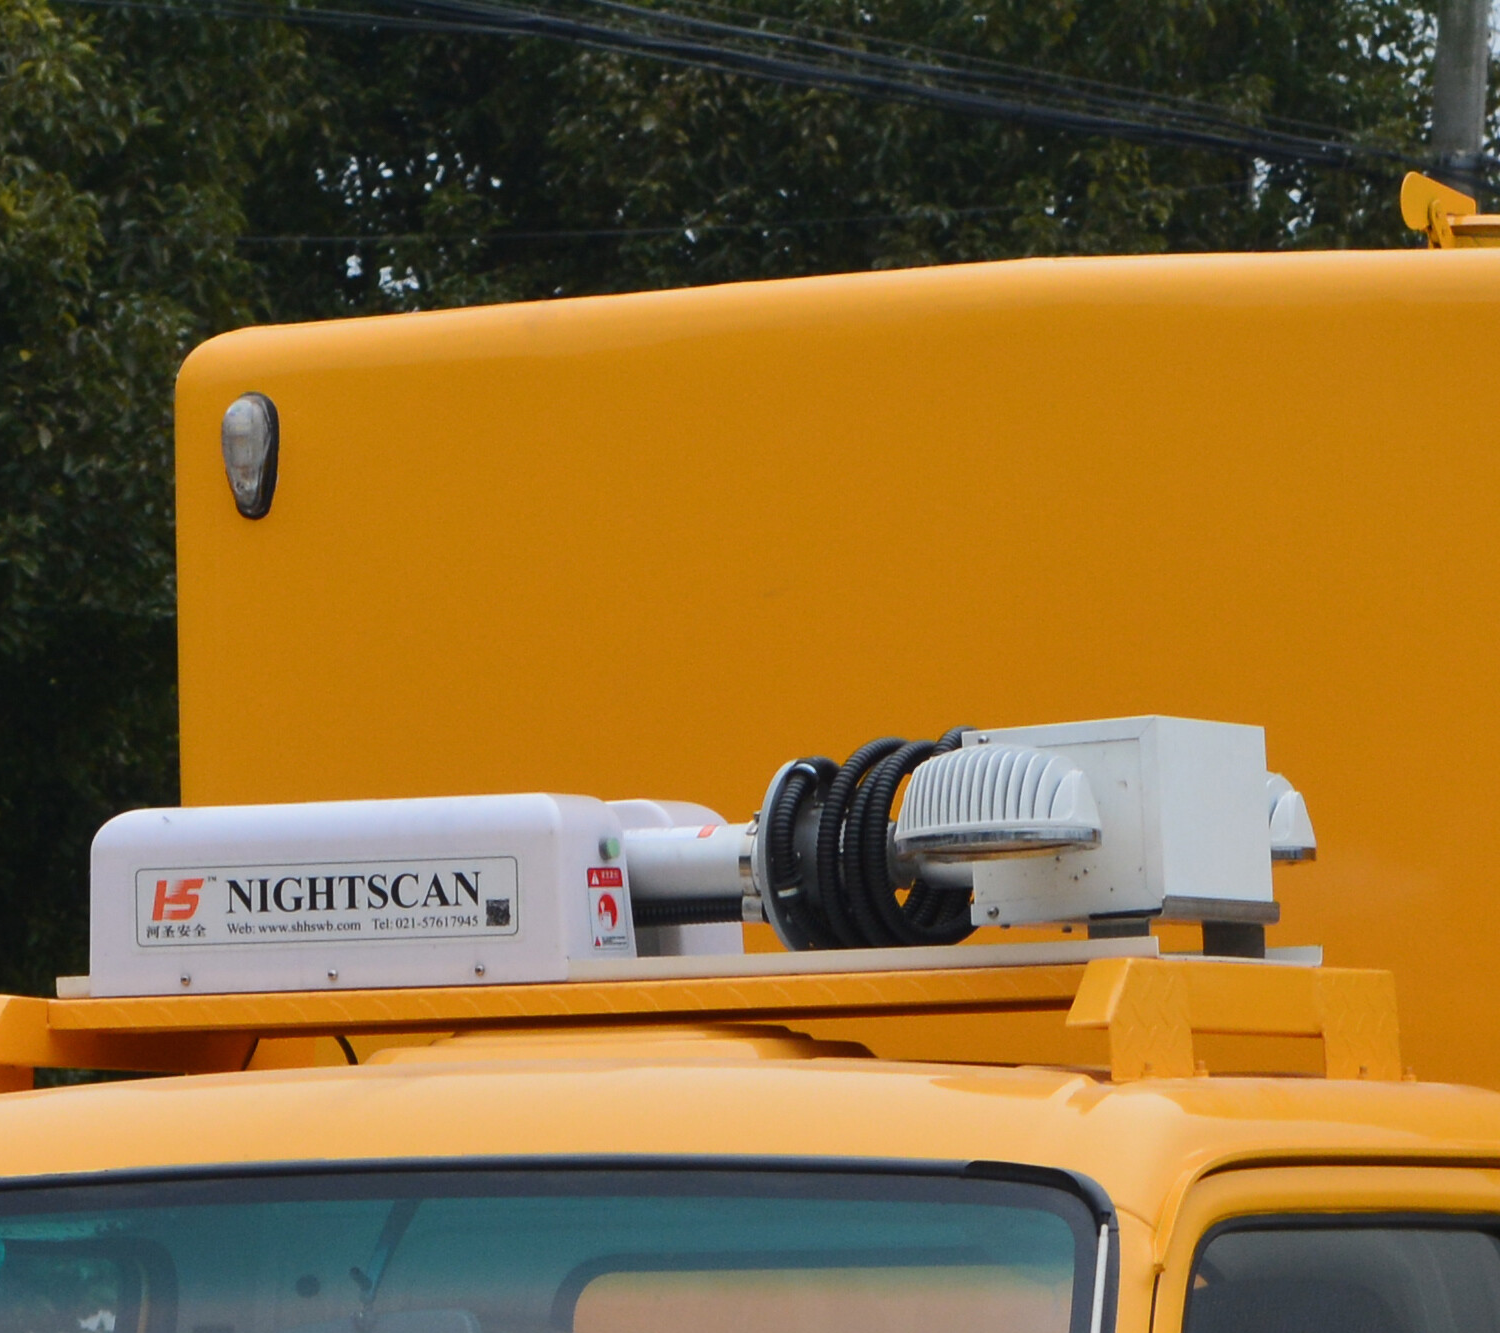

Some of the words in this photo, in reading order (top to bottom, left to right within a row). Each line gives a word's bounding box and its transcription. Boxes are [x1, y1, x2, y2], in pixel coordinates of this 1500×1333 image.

[226, 872, 481, 914] NIGHTSCAN
[227, 922, 255, 934] Web:
[258, 921, 361, 933] www.shhswb.com
[372, 917, 392, 930] Tel:
[395, 916, 479, 929] 021-57617945
